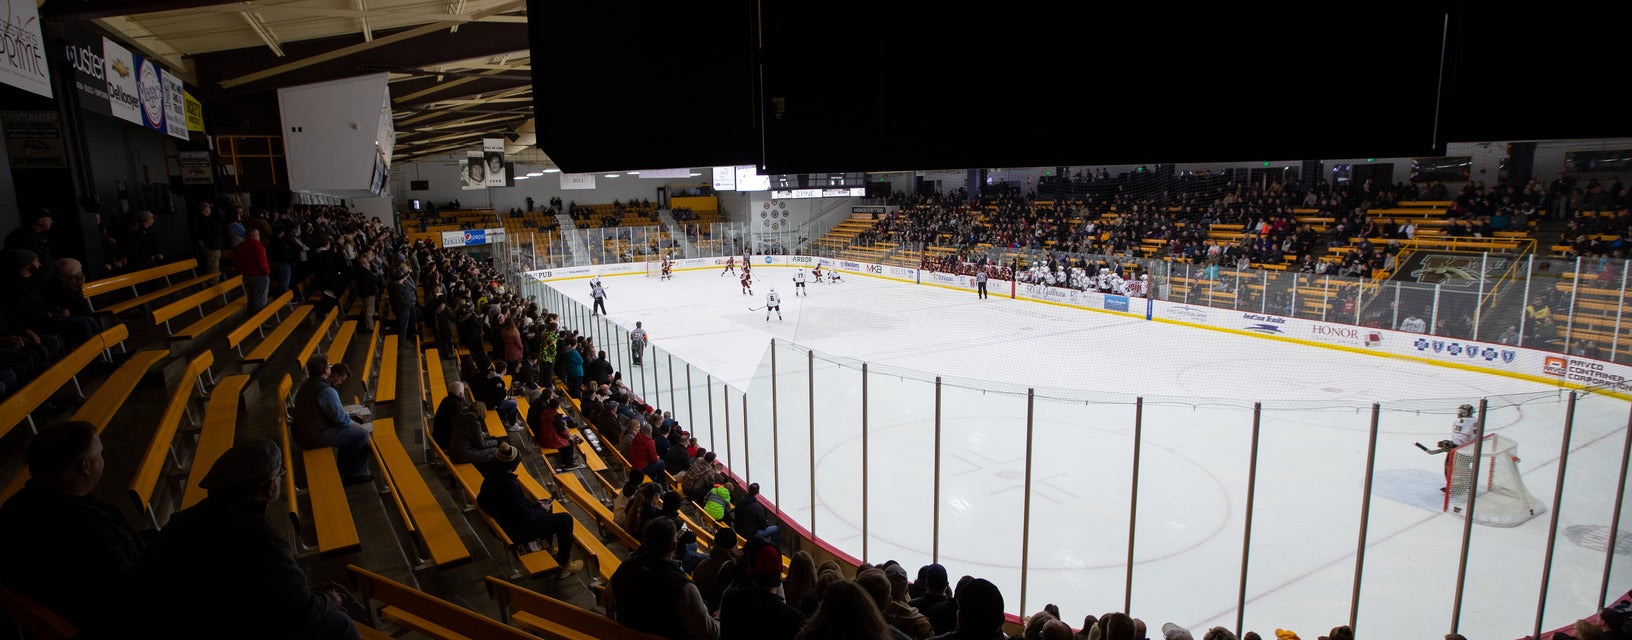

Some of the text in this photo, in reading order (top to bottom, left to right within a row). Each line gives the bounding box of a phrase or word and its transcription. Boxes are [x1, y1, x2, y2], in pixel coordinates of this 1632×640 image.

[538, 271, 552, 279] PUB
[866, 264, 883, 275] MKB
[1242, 312, 1287, 326] Indian Trails
[1312, 324, 1360, 340] HONOR
[1569, 366, 1626, 382] CONTAINER
